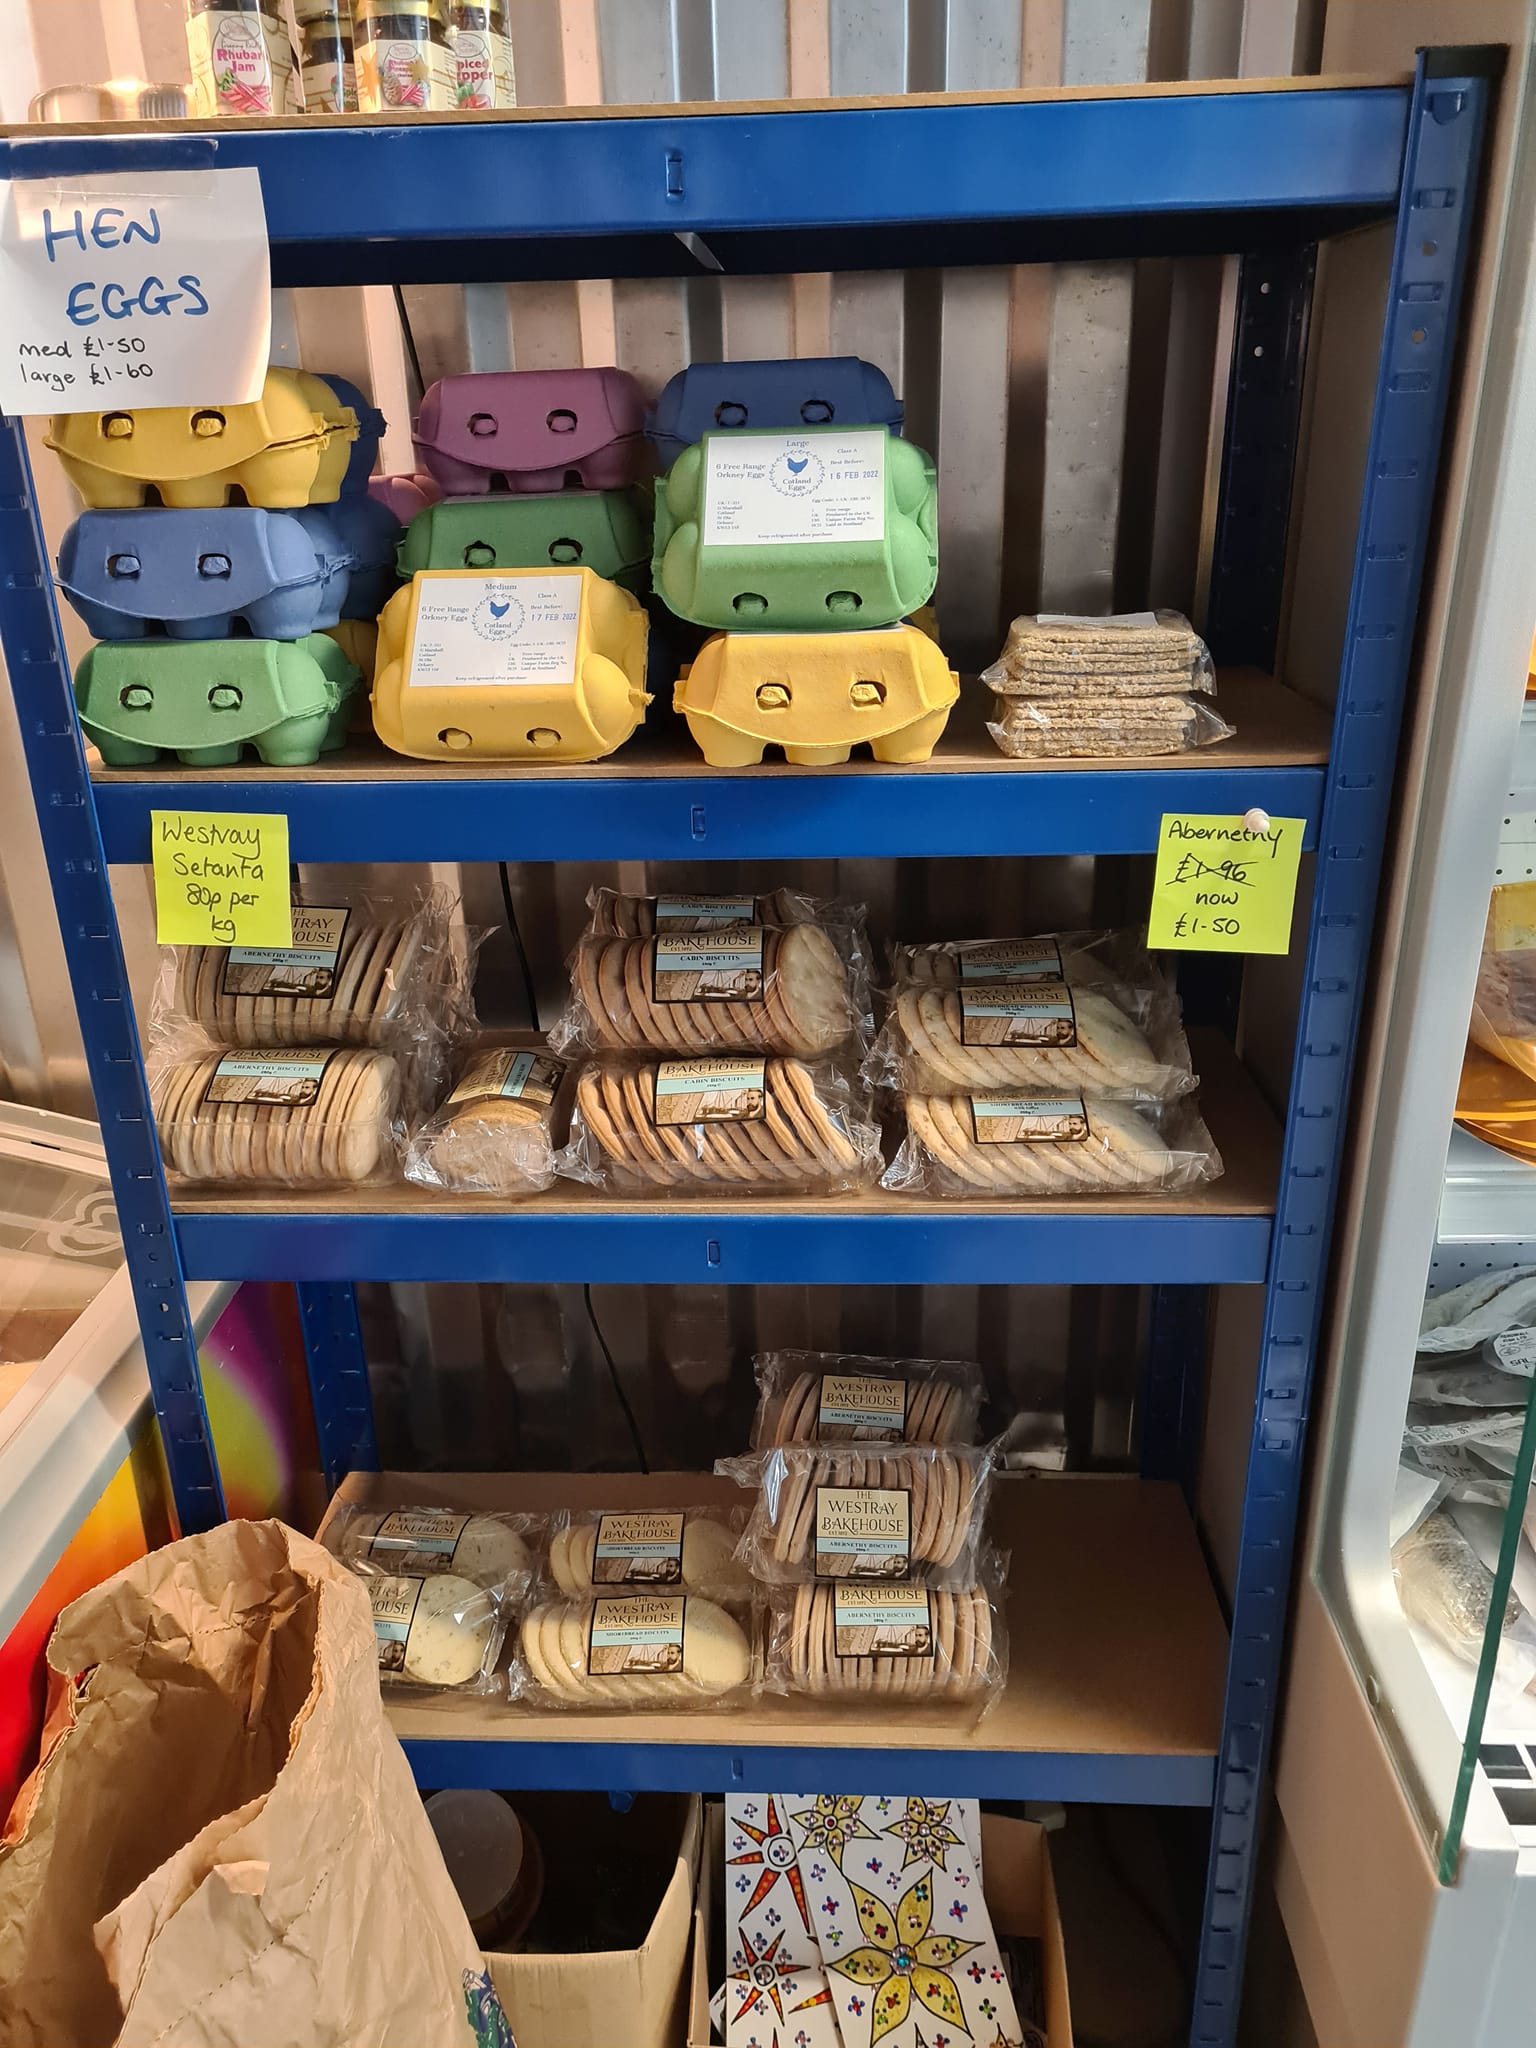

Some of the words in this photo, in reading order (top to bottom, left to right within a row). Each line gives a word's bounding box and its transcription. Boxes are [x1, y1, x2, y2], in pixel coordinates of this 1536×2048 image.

[216, 49, 262, 61] Rhubar
[230, 61, 256, 73] Jam
[456, 59, 489, 71] piced
[43, 208, 161, 262] HEN
[66, 275, 209, 326] EGGS
[19, 341, 72, 358] med
[20, 363, 76, 392] large
[845, 471, 859, 479] FEB
[863, 470, 879, 478] 2022
[421, 614, 449, 622] Orkney
[451, 614, 468, 622] Eggs
[562, 612, 577, 620] 2022
[163, 816, 261, 860] Westray
[173, 852, 264, 881] Setanta
[186, 883, 222, 912] 80p
[230, 891, 260, 913] per
[1196, 892, 1239, 905] now
[293, 908, 306, 916] HE
[212, 915, 236, 943] kg
[293, 917, 335, 929] TRAY
[663, 935, 756, 950] BAKEHOUSE
[968, 993, 1064, 1003] BAKEHOUSE
[664, 1063, 757, 1075] BAKEHOUSE
[832, 1382, 896, 1394] WESTRAY
[825, 1392, 900, 1408] BAKEHOUSE
[856, 1490, 872, 1499] THE
[828, 1499, 898, 1515] WESTRAY
[384, 1523, 457, 1535] BAKEHOUSE
[611, 1519, 673, 1528] WESTRAY
[821, 1516, 904, 1535] BAKEHOUSE
[603, 1529, 677, 1541] BAKEHOUSE
[840, 1589, 923, 1605] BAKEHOUSE
[607, 1602, 673, 1613] WESTRAY
[598, 1612, 678, 1627] BAKEHOUSE
